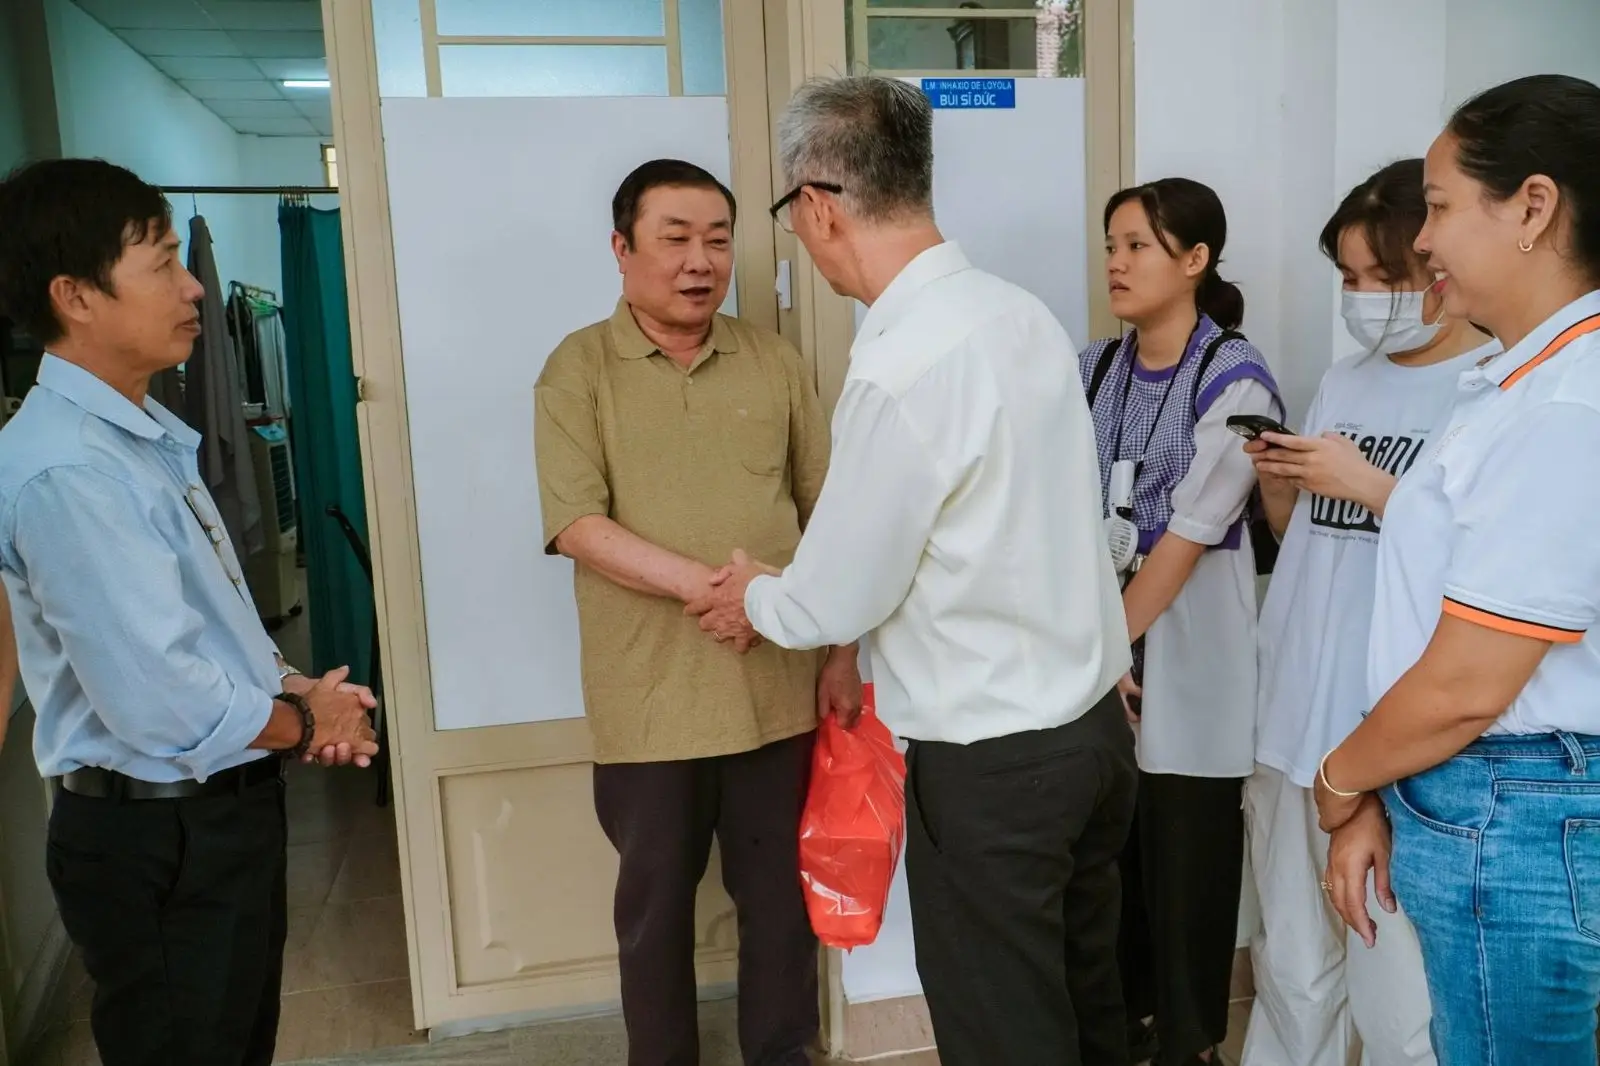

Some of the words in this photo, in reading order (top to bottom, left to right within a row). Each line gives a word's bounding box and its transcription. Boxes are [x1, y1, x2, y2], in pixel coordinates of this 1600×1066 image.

[971, 81, 981, 90] DE
[983, 81, 1012, 90] LOYOLA
[940, 92, 958, 106] BÙI
[973, 91, 996, 106] ĐỨC
